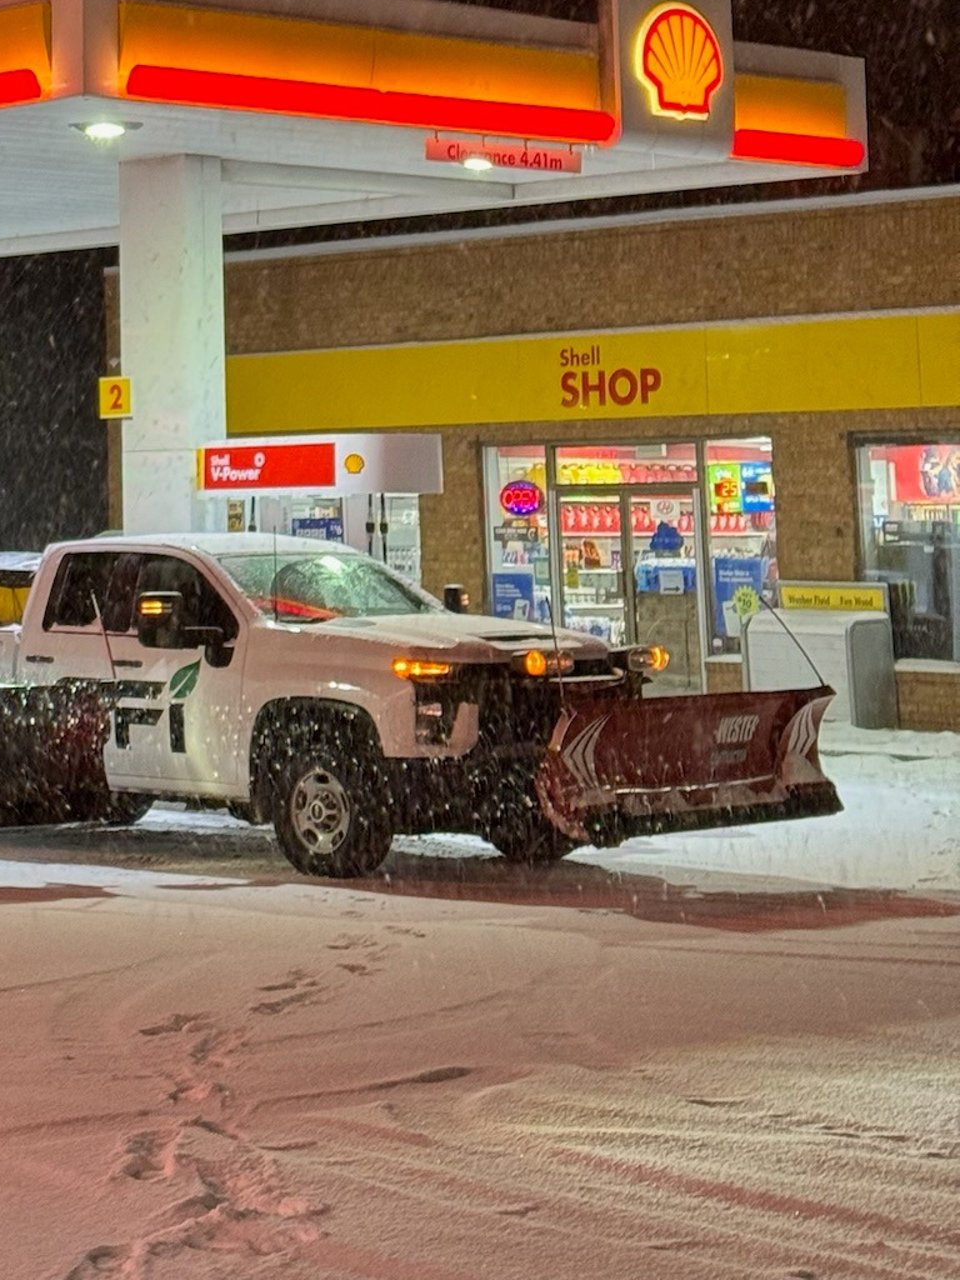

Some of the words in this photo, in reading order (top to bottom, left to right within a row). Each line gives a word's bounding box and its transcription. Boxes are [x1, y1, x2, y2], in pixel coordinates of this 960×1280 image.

[520, 151, 563, 170] 4.41m
[560, 346, 600, 367] Shell
[109, 383, 123, 410] 2
[561, 368, 662, 409] SHOP
[210, 454, 231, 466] Shell
[211, 466, 262, 482] V-Power
